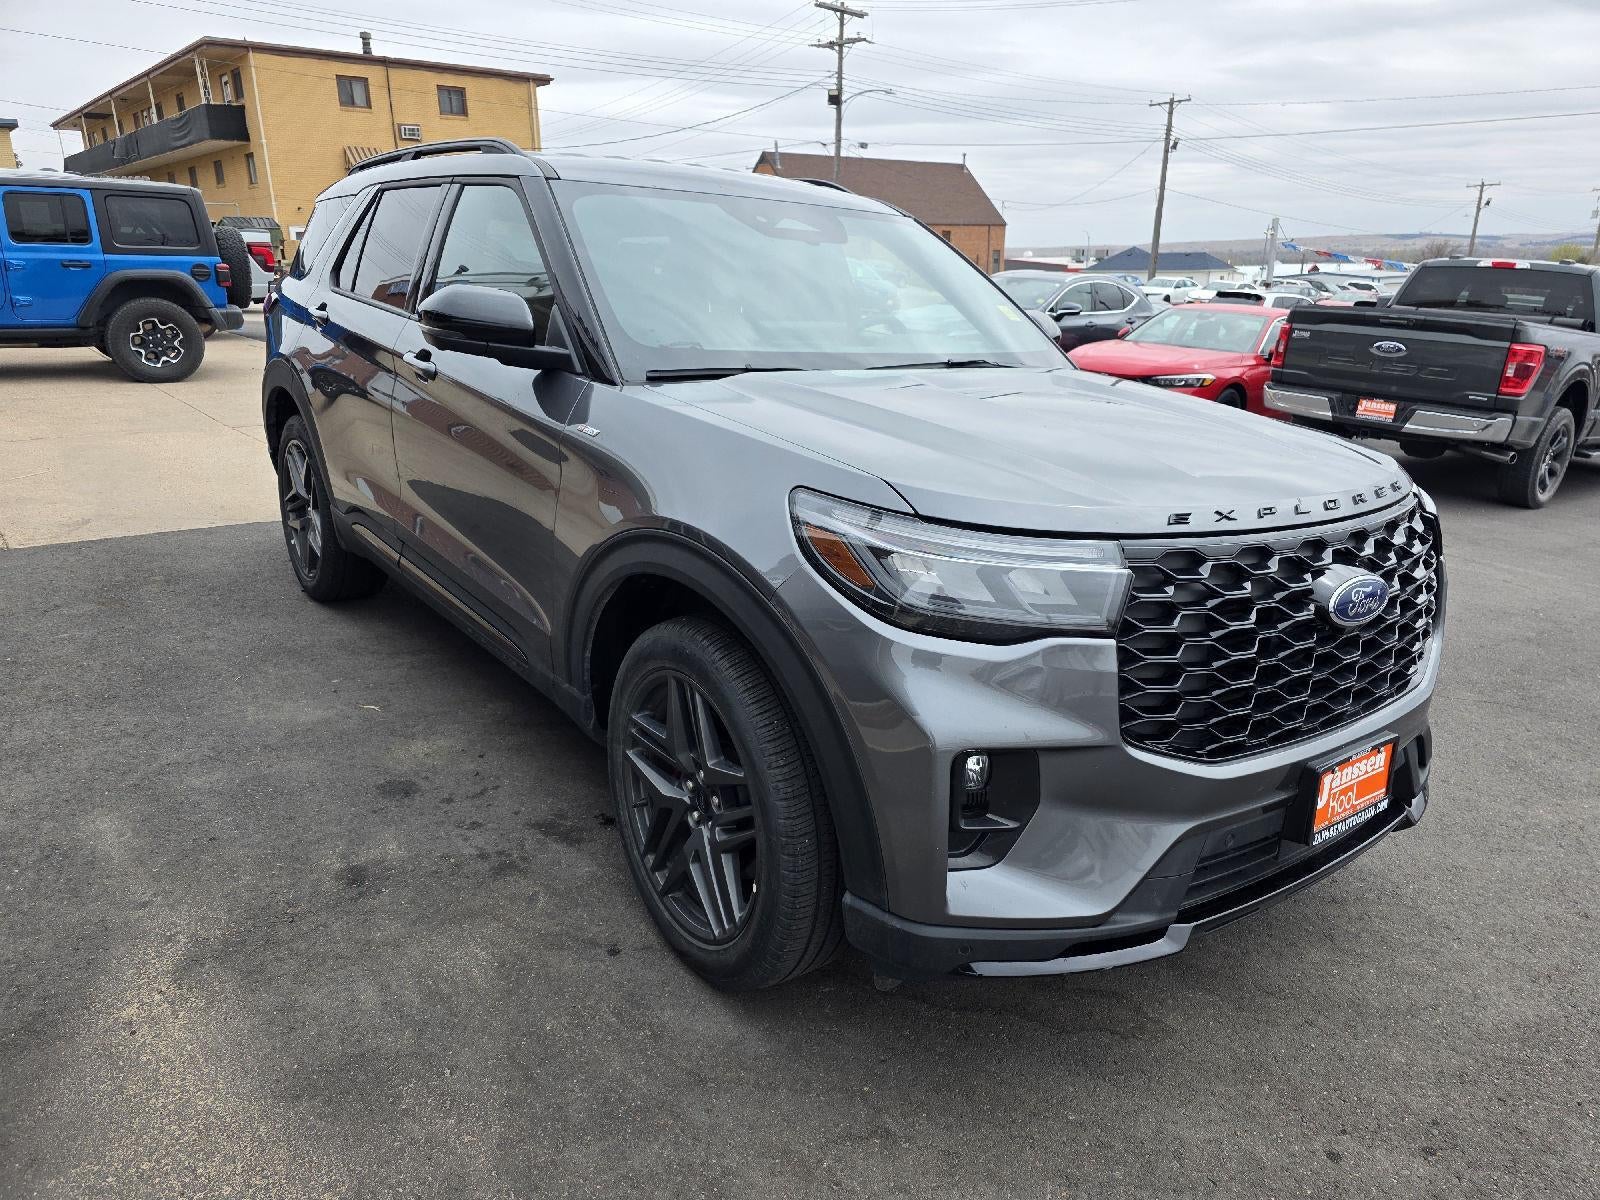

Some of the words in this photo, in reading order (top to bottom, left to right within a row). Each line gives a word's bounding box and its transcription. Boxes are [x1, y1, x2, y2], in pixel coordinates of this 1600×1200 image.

[1358, 399, 1398, 411] Janssen
[1167, 480, 1403, 526] EXPLORER
[1348, 586, 1380, 616] Ford
[1317, 749, 1386, 809] Janssen
